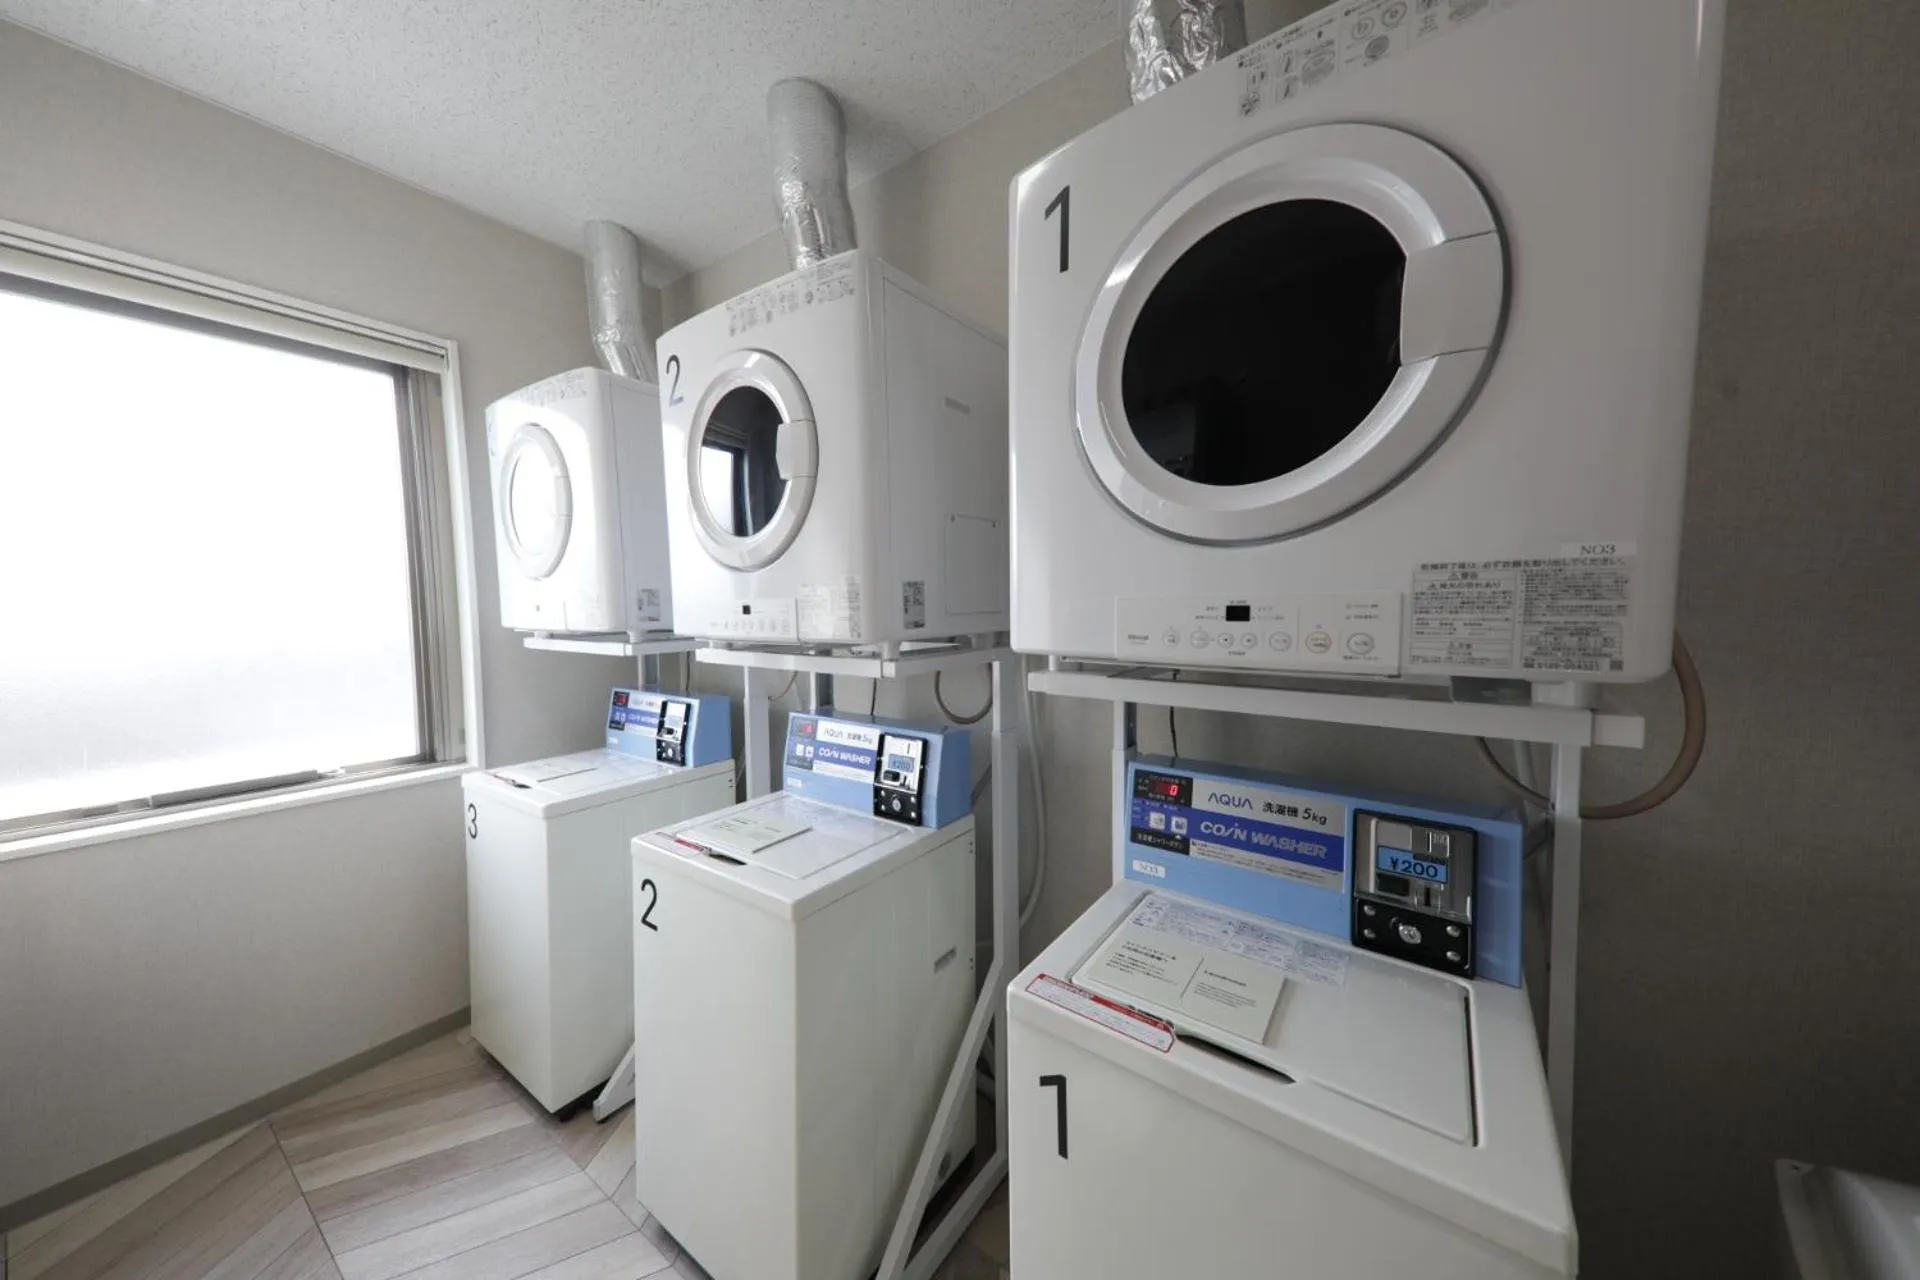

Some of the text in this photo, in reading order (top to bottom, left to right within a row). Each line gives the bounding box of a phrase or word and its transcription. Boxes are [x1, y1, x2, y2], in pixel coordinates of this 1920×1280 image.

[1045, 186, 1070, 273] 1
[667, 354, 683, 404] 2
[467, 803, 478, 840] 3
[1207, 791, 1253, 811] AQUA
[1262, 801, 1299, 818] 洗濯機
[1302, 807, 1328, 826] 5kg
[1251, 831, 1328, 859] WASHER
[1389, 855, 1438, 878] ¥200
[641, 879, 657, 931] 2
[1040, 1075, 1068, 1159] 1
